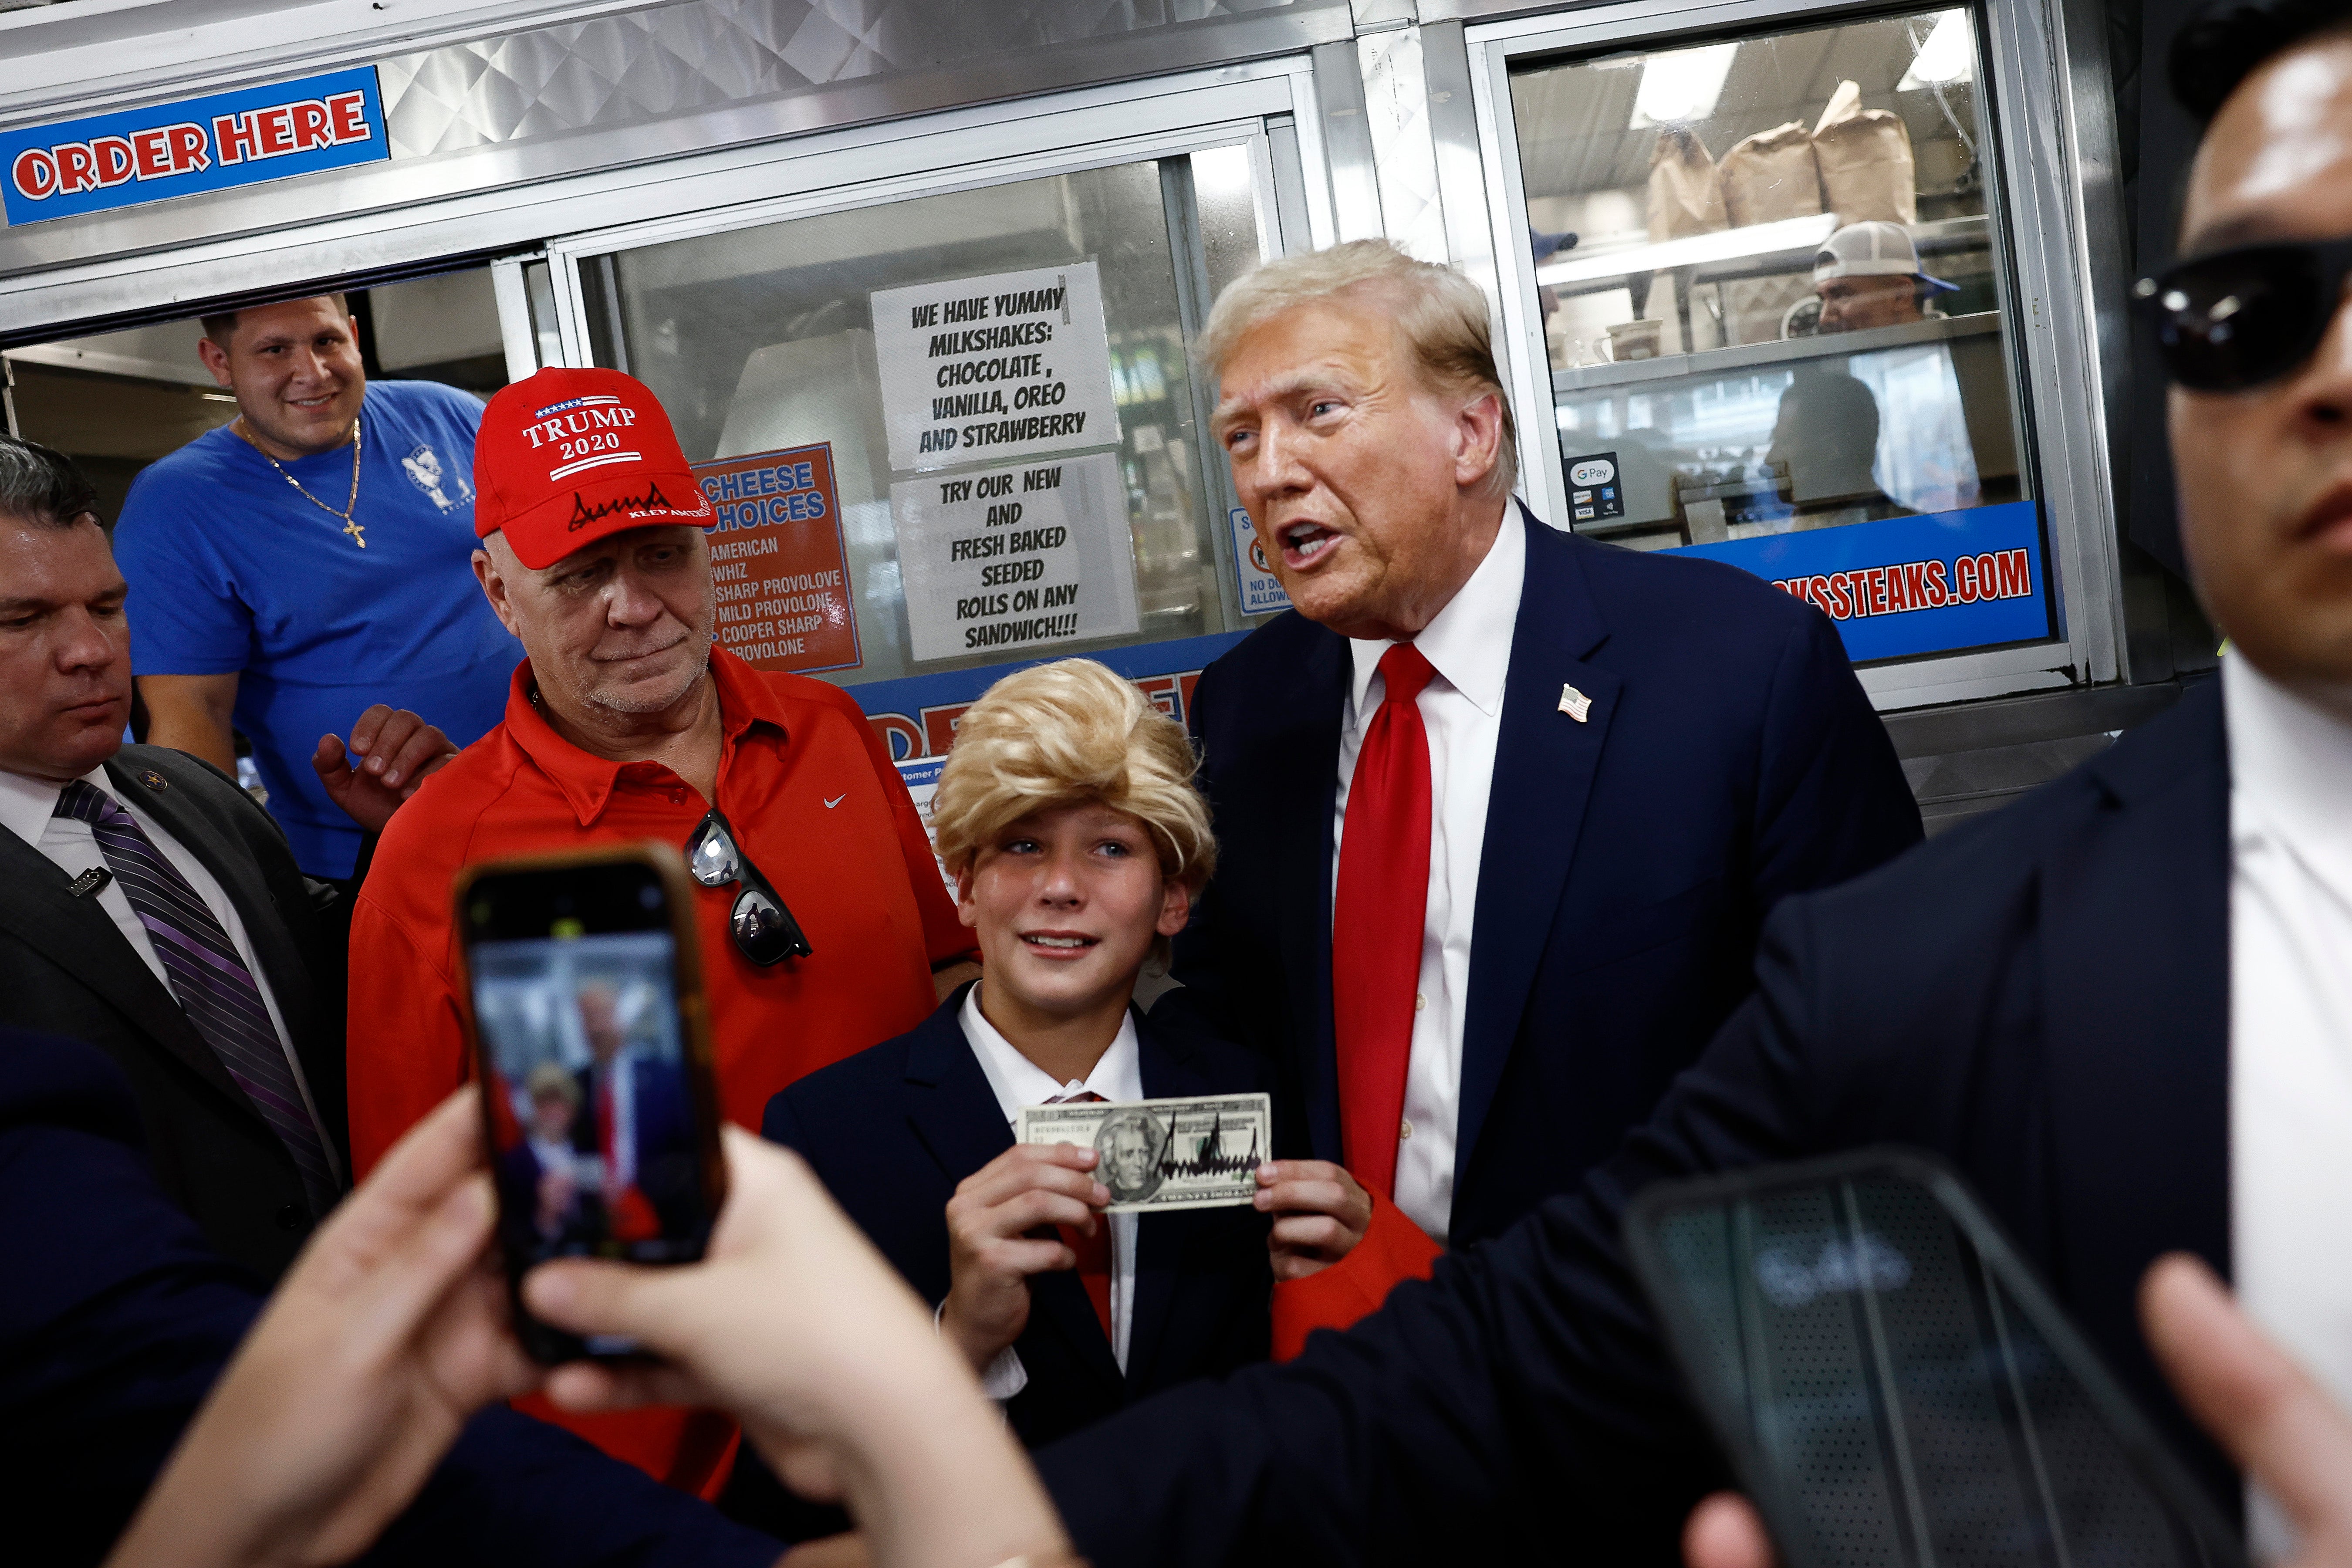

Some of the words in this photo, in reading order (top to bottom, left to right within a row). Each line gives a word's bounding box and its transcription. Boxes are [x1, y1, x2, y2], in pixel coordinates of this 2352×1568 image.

[12, 122, 212, 201] ORDER
[212, 90, 371, 167] HERE
[912, 302, 939, 329] WE
[943, 296, 989, 324] HAVE
[994, 287, 1065, 317] YUMMY
[928, 321, 1052, 358] MILKSHAKES:
[937, 353, 1041, 388] CHOCOLATE
[933, 390, 1008, 420] VANILLA,
[1014, 382, 1065, 410] OREO
[522, 408, 636, 448] TRUMP
[919, 428, 957, 453] AND
[962, 412, 1086, 448] STRAWBERRY
[560, 432, 620, 460] 2020
[700, 462, 815, 504] CHEESE
[941, 480, 972, 504] TRY
[977, 474, 1013, 498] OUR
[1024, 466, 1062, 493] NEW
[1590, 468, 1607, 478] Pay
[629, 509, 667, 518] KEEP
[703, 490, 826, 535] HOICES
[986, 502, 1022, 527] AND
[711, 537, 778, 562] AMERICAN
[951, 534, 1004, 562] FRESH
[1009, 526, 1066, 554] BAKED
[712, 562, 748, 582] WHIZ
[981, 559, 1044, 588] SEEDED
[1250, 580, 1264, 591] NO
[1771, 548, 2032, 621] SSTEAKS.COM
[716, 581, 759, 602] SHARP
[719, 603, 752, 623] MILD
[755, 591, 833, 618] PROVOLONE
[956, 593, 1007, 620] ROLLS
[1013, 589, 1038, 611] ON
[1043, 584, 1078, 608] ANY
[1250, 590, 1291, 605] ALLOW
[722, 621, 775, 643] COOPER
[778, 615, 822, 635] SHARP
[965, 613, 1077, 648] SANDWICH!!!
[903, 771, 932, 781] tomer
